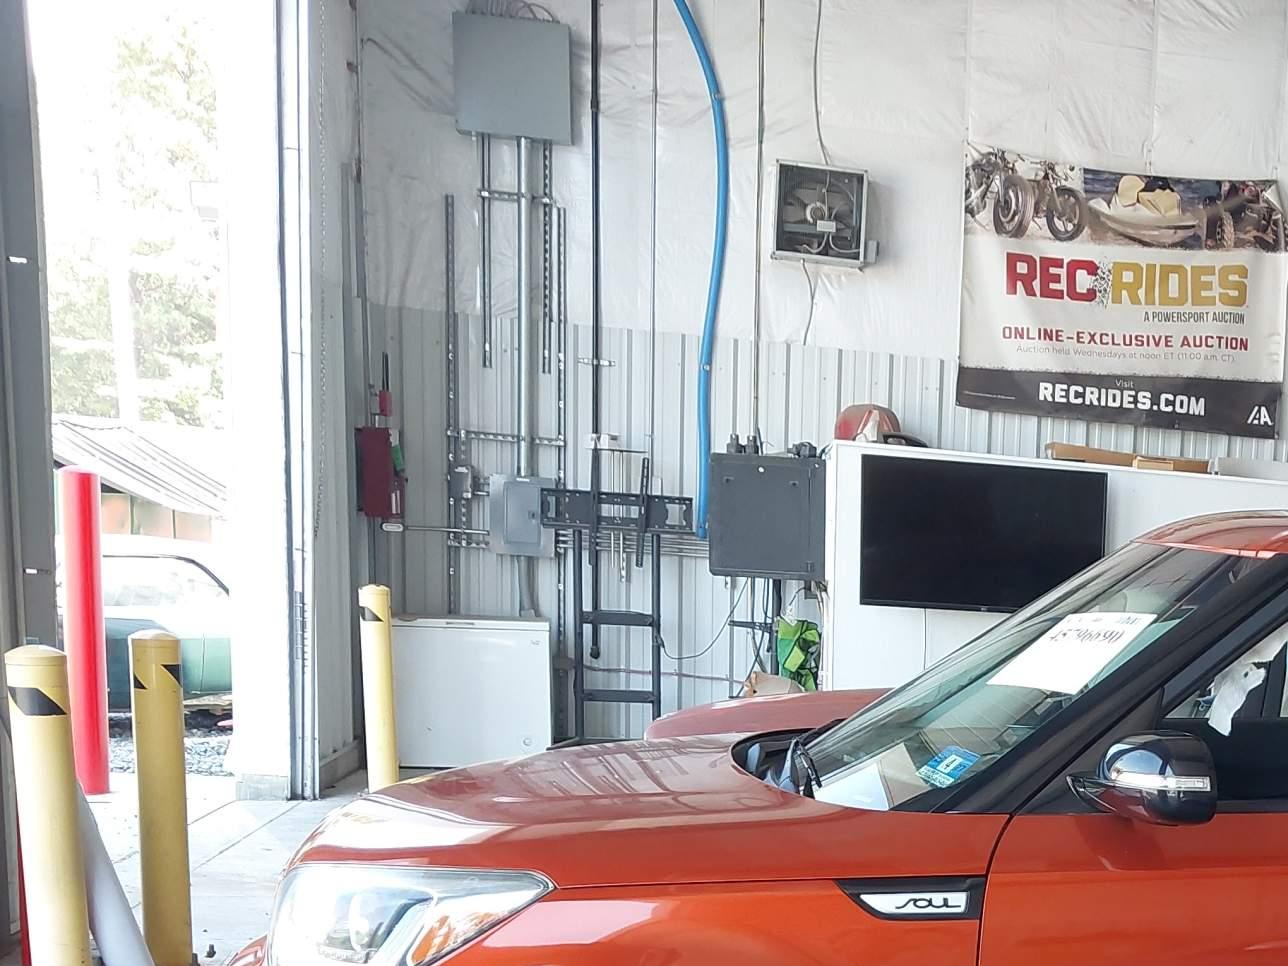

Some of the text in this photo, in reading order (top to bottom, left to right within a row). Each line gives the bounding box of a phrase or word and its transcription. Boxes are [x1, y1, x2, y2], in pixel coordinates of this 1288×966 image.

[1005, 252, 1248, 308] REC RIDES
[1143, 311, 1245, 325] A POWERSPORT AUCTION
[1002, 326, 1249, 351] ONLINE-EXCLUSIVE AUCTION
[1016, 345, 1050, 353] Auction
[1052, 346, 1071, 356] held
[1073, 346, 1126, 359] Wednesdays
[1128, 351, 1137, 359] at
[1163, 352, 1174, 360] ET
[1177, 352, 1202, 361] (1100
[1115, 379, 1134, 388] Visit
[1038, 382, 1206, 416] RECRIDES.COM
[895, 897, 962, 910] SOUL
